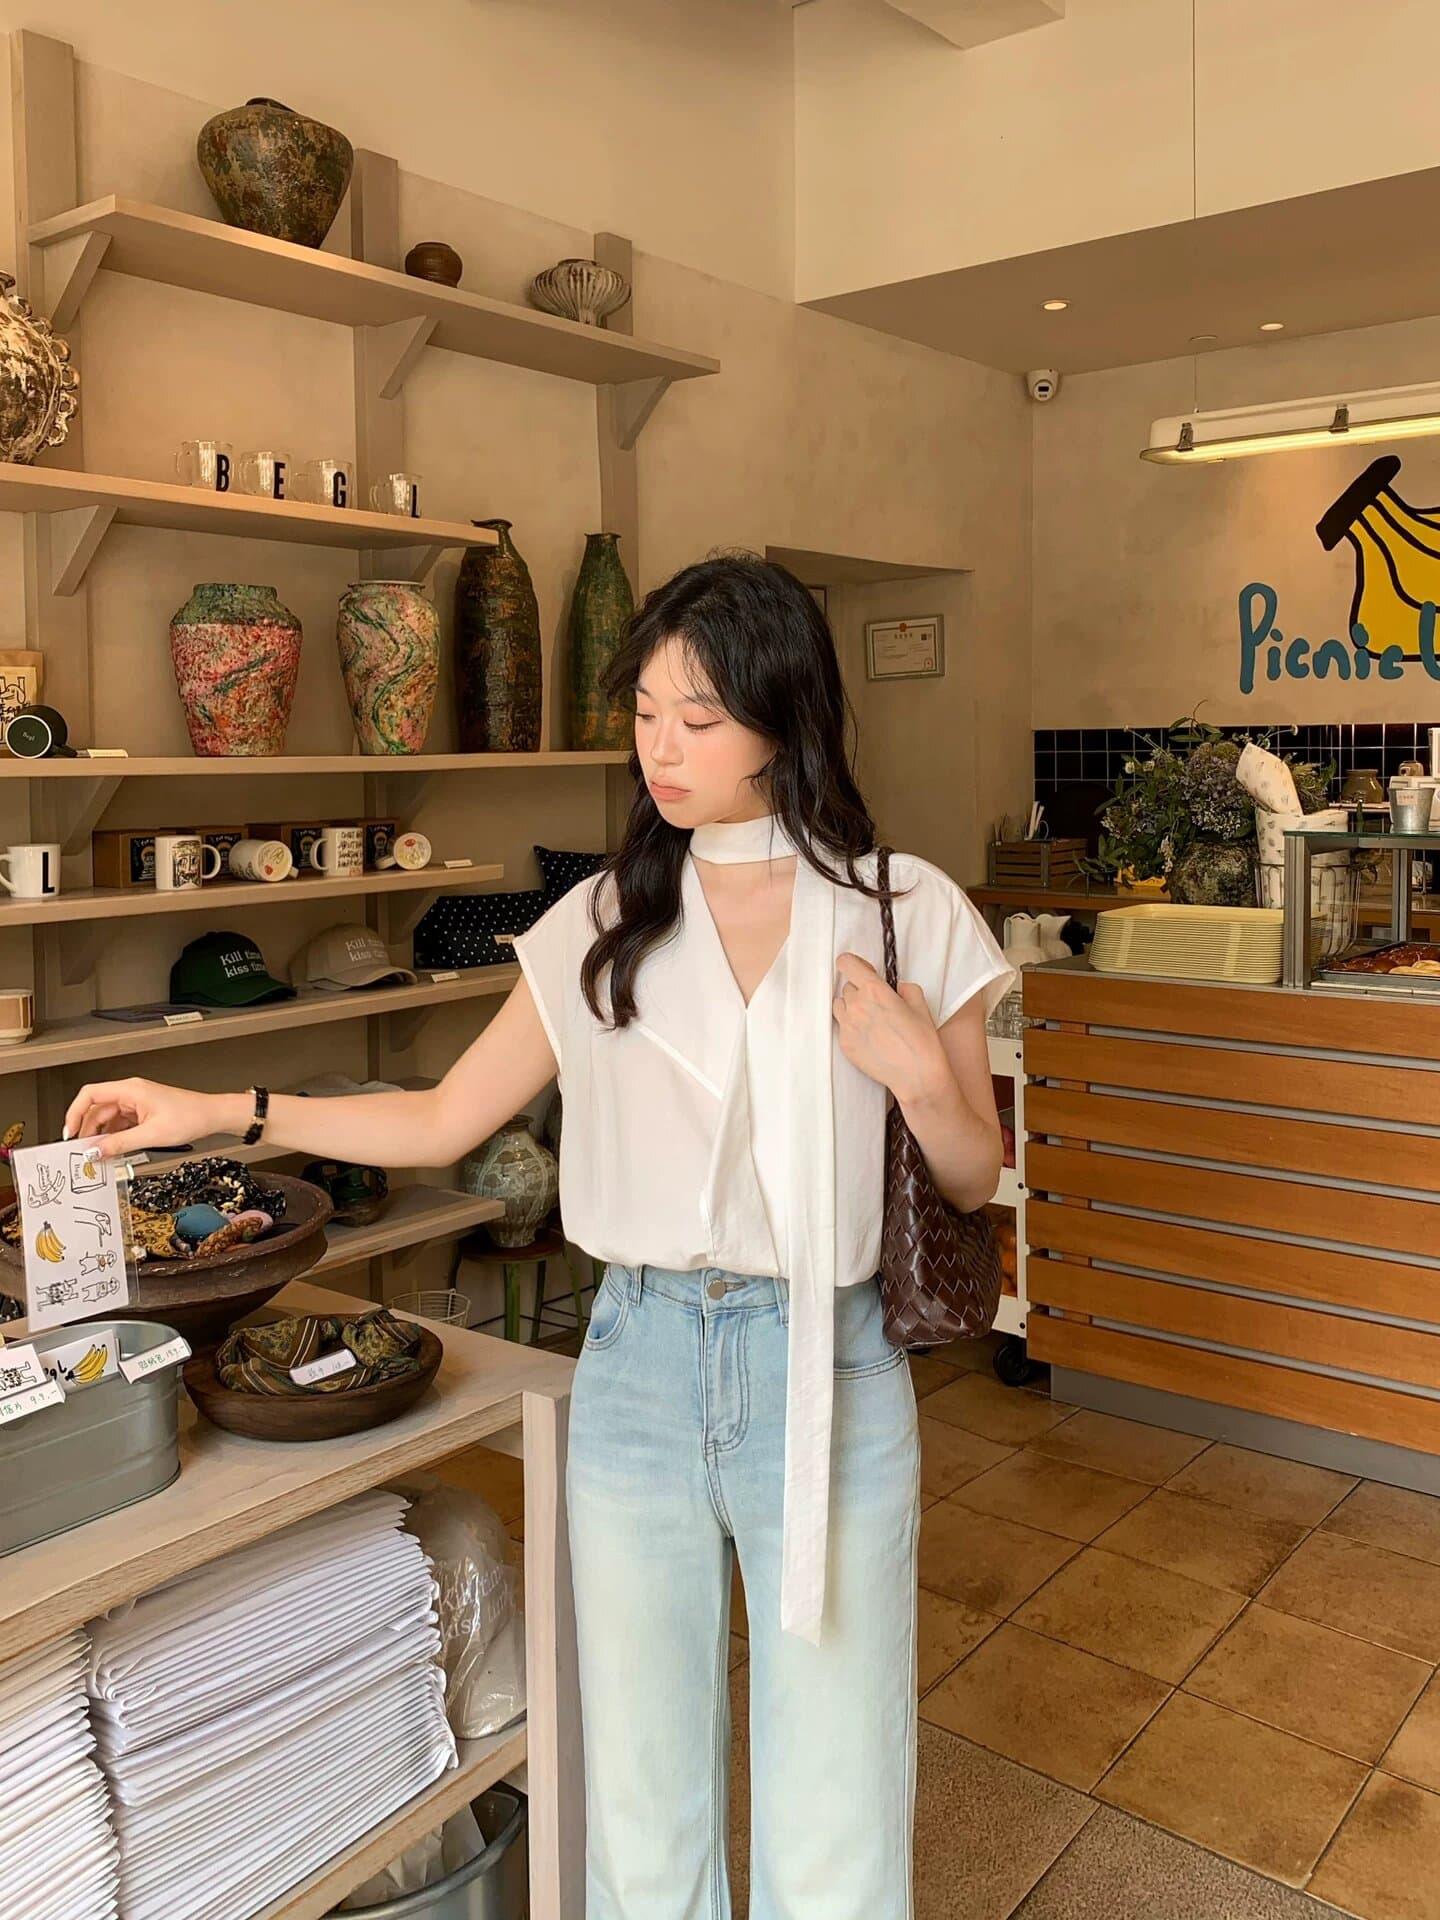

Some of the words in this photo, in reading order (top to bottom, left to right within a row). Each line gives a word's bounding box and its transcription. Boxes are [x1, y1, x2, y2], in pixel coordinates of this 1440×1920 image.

[216, 454, 230, 492] B
[273, 462, 286, 500] E
[333, 471, 347, 508] G
[1239, 583, 1404, 694] Picnic
[42, 852, 55, 893] L
[220, 949, 244, 966] Kill
[224, 965, 250, 979] kiss
